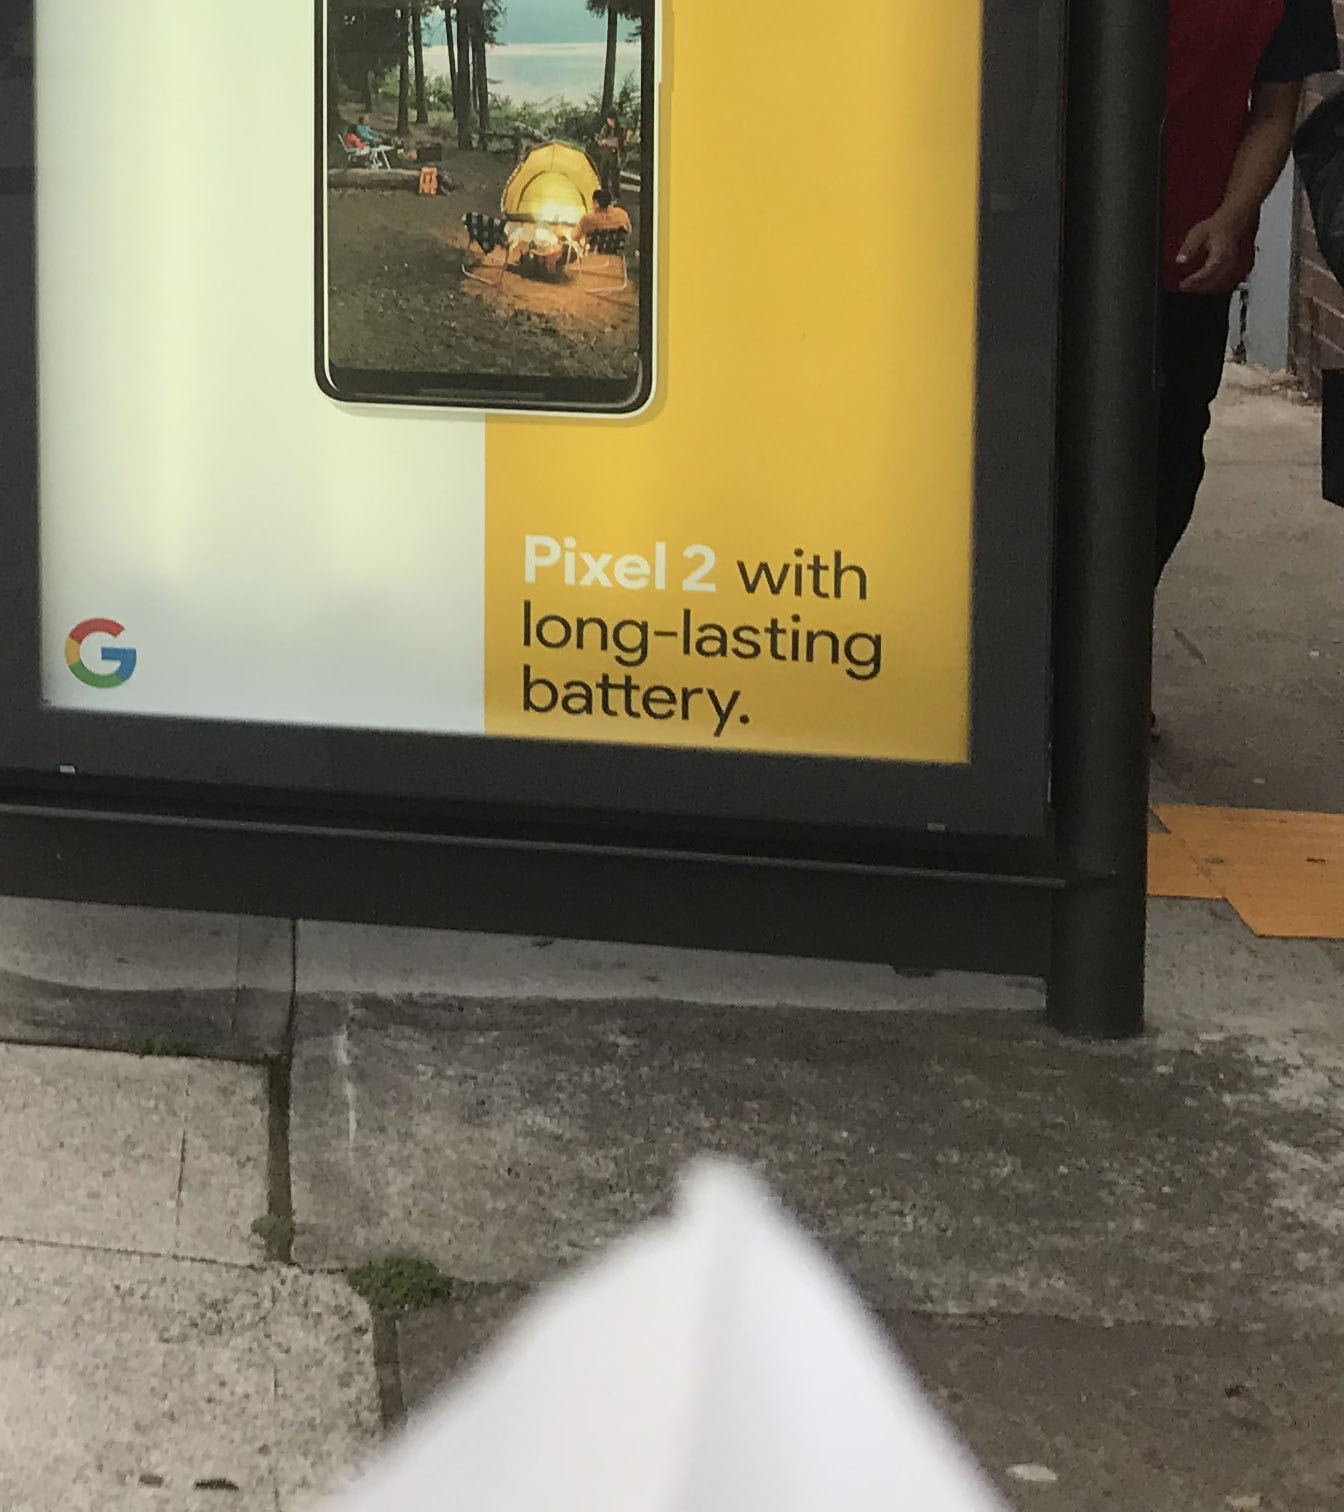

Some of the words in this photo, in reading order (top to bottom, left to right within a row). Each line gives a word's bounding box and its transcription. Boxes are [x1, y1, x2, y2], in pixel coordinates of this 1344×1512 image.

[525, 534, 666, 590] Pixel
[682, 543, 717, 593] 2
[736, 548, 868, 600] with
[522, 599, 882, 681] long-lasting
[522, 663, 750, 738] battery.
